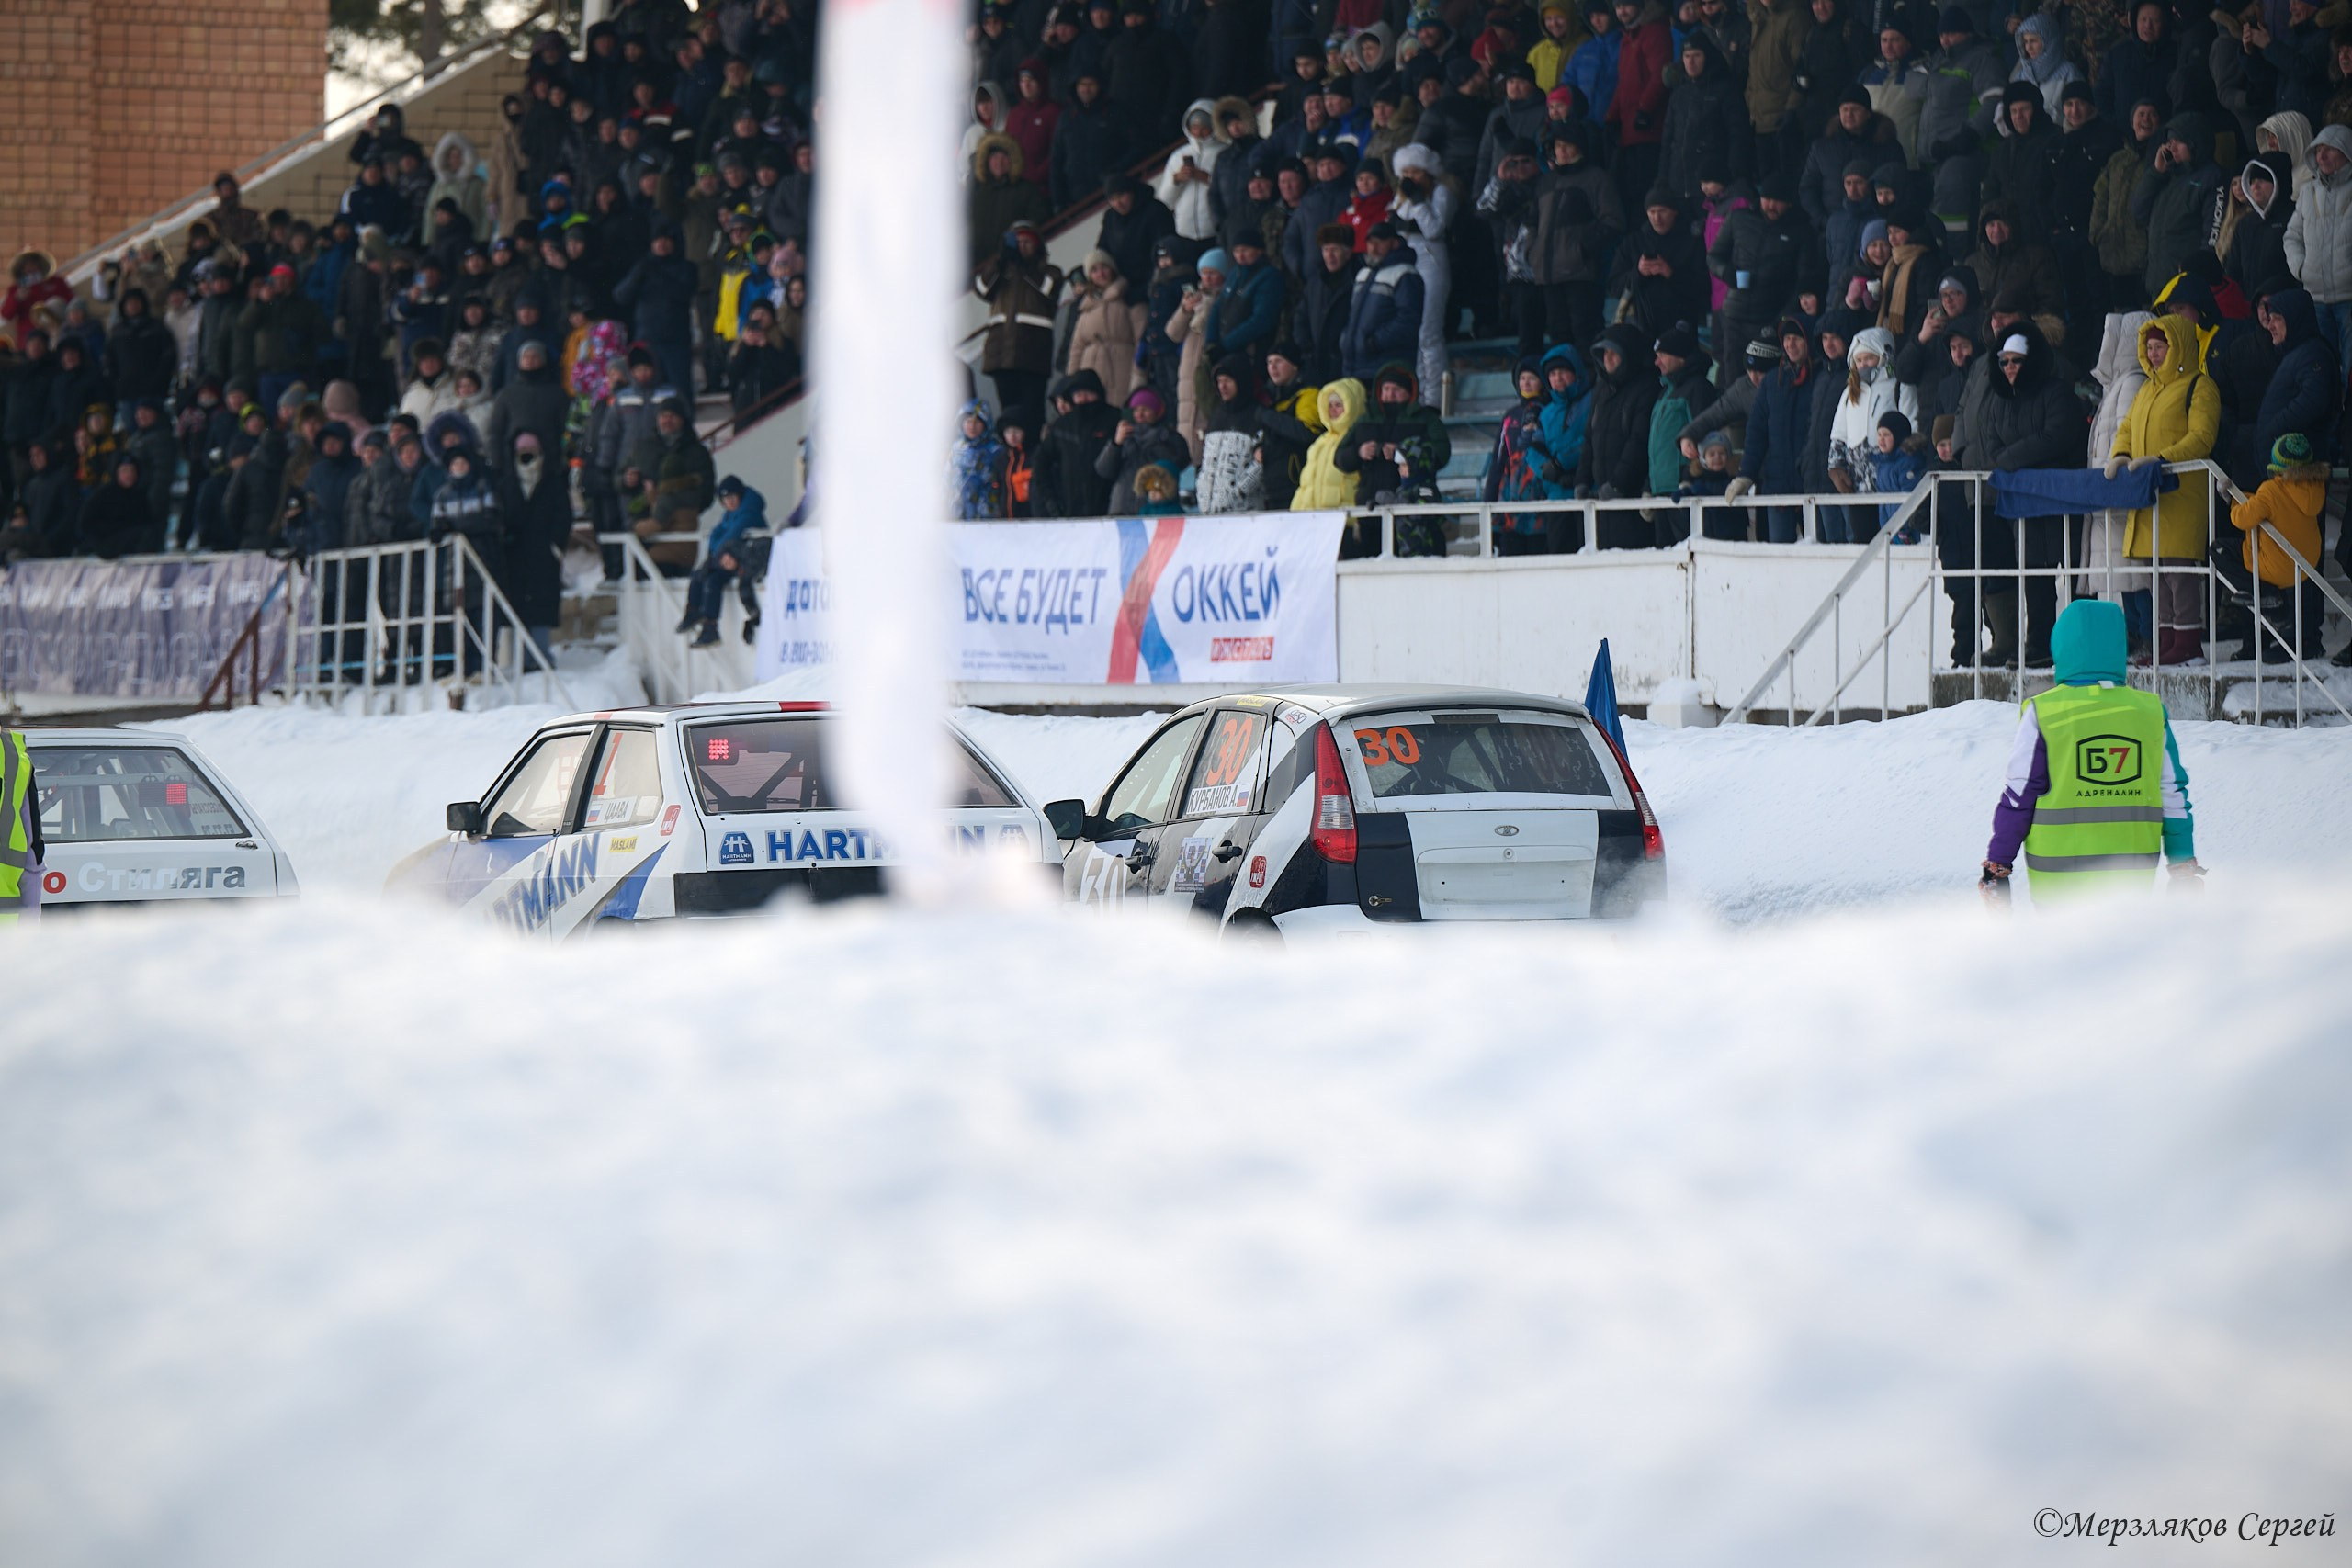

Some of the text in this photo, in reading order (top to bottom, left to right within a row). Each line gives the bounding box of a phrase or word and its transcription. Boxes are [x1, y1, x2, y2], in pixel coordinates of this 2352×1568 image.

[961, 568, 1014, 624] ВСЕ
[1015, 568, 1108, 636] БУДЕТ
[1205, 716, 1253, 786] 30
[1352, 727, 1420, 766] 30
[2086, 748, 2131, 774] Б7
[1187, 785, 1232, 814] КУРБАНОВ
[2076, 789, 2142, 797] АДРЕНАЛИН
[77, 861, 246, 893] Стиляга
